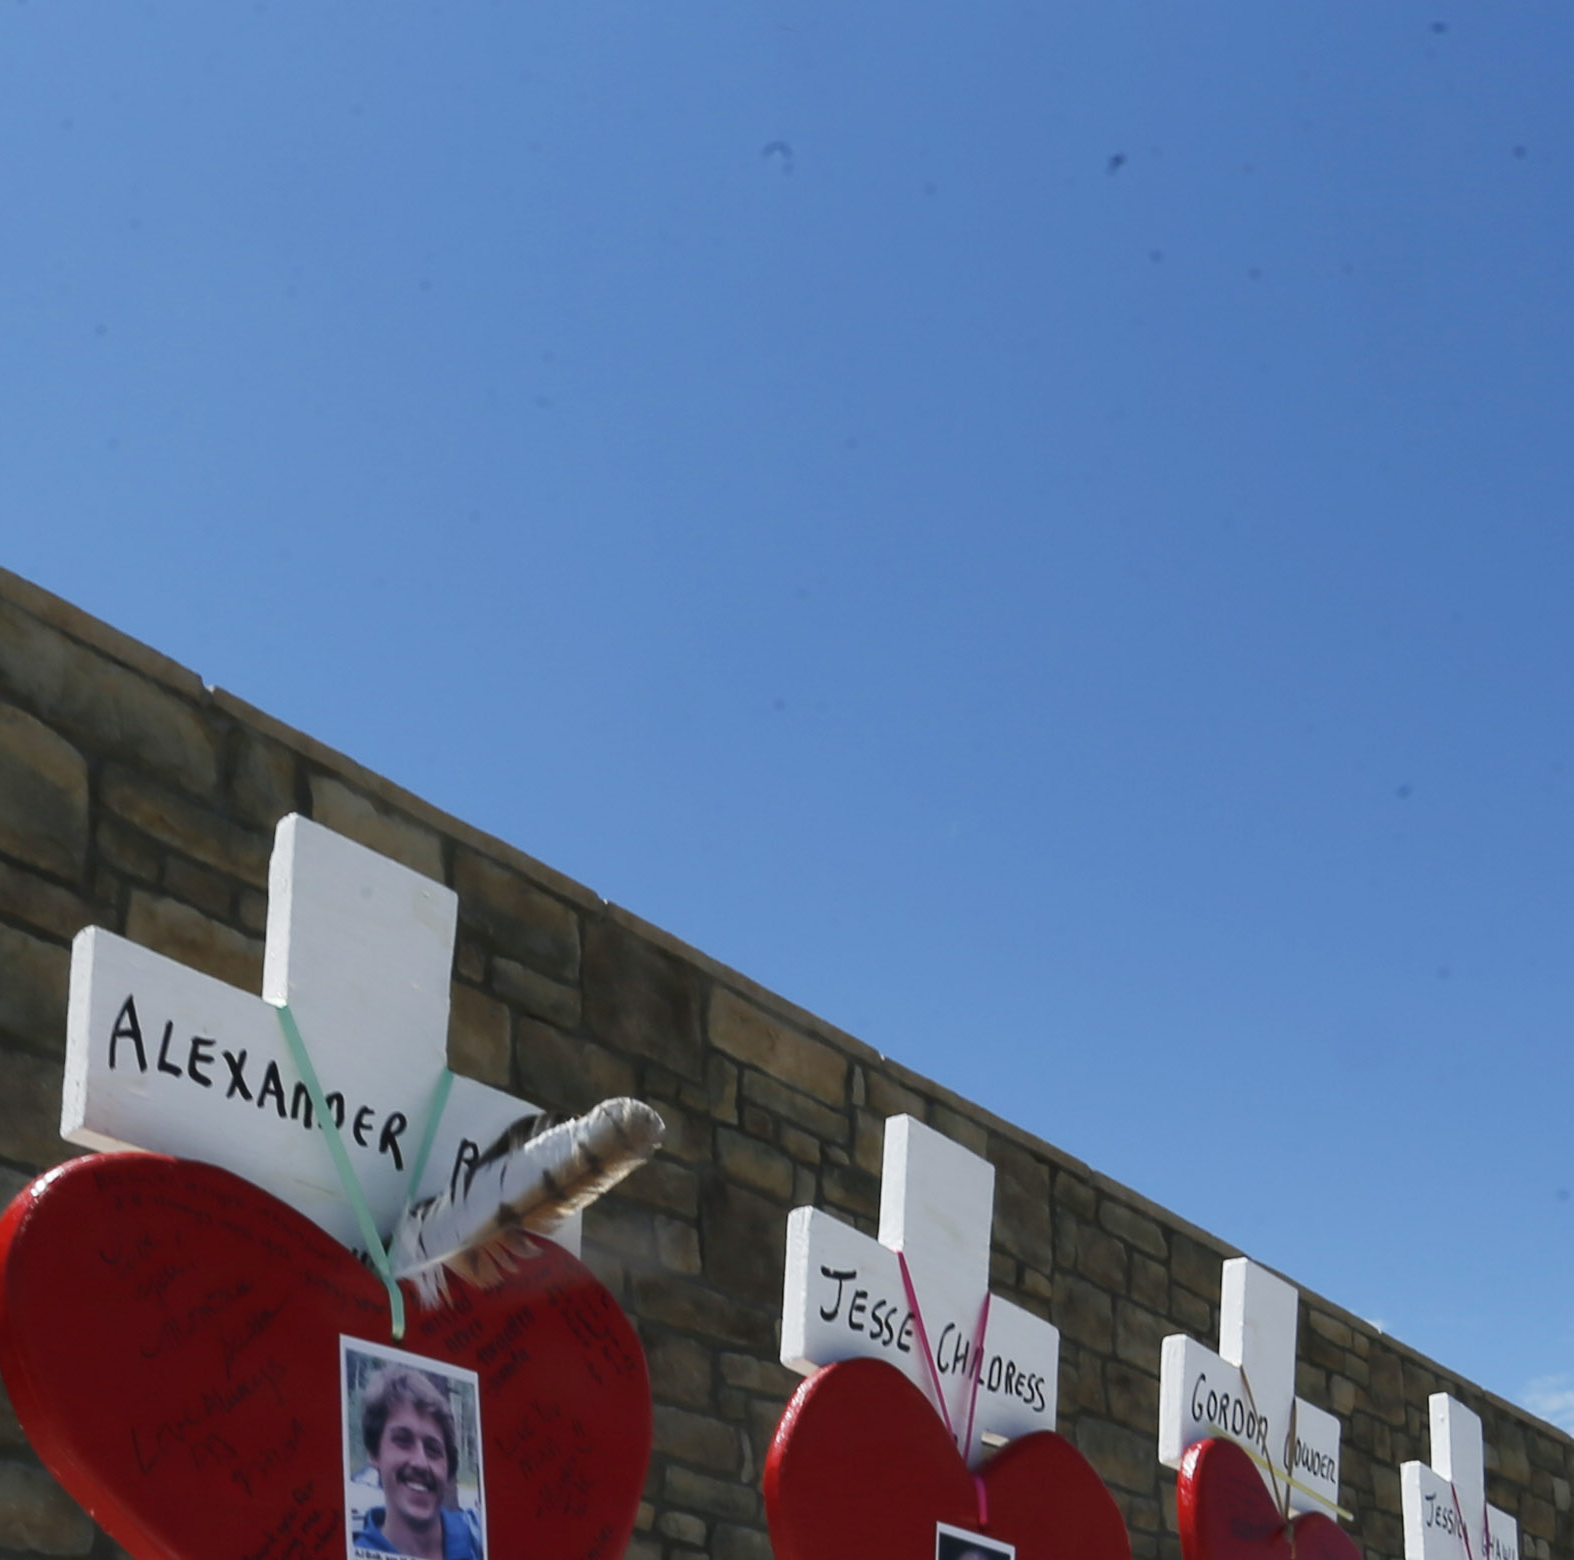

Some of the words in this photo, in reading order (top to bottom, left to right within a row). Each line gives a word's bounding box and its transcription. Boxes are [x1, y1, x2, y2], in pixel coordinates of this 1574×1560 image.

[108, 994, 408, 1171] ALEXANDER
[819, 1265, 916, 1353] JESSE
[1425, 1492, 1469, 1541] JESSIC
